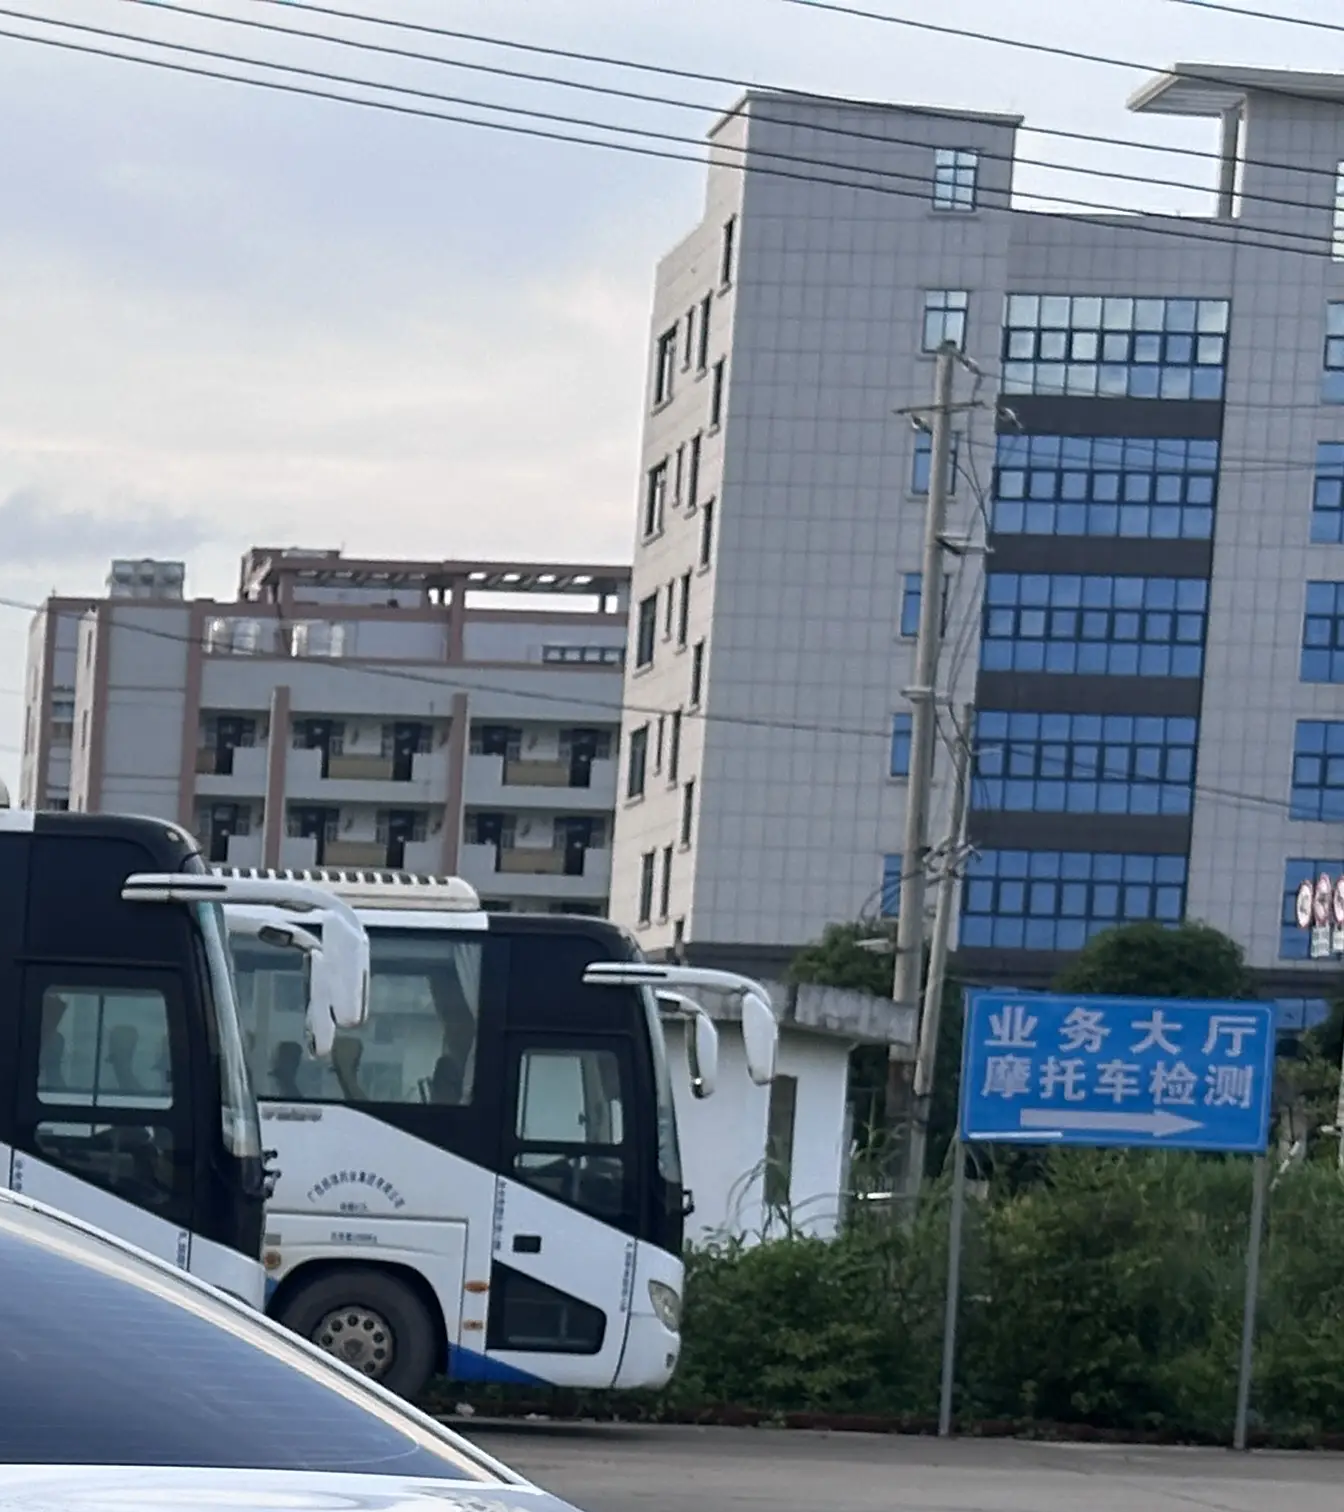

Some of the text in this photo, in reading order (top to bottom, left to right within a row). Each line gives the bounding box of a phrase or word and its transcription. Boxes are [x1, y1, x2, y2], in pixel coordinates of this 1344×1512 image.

[984, 1004, 1258, 1058] 业务大厅
[980, 1054, 1254, 1108] 摩托车检测
